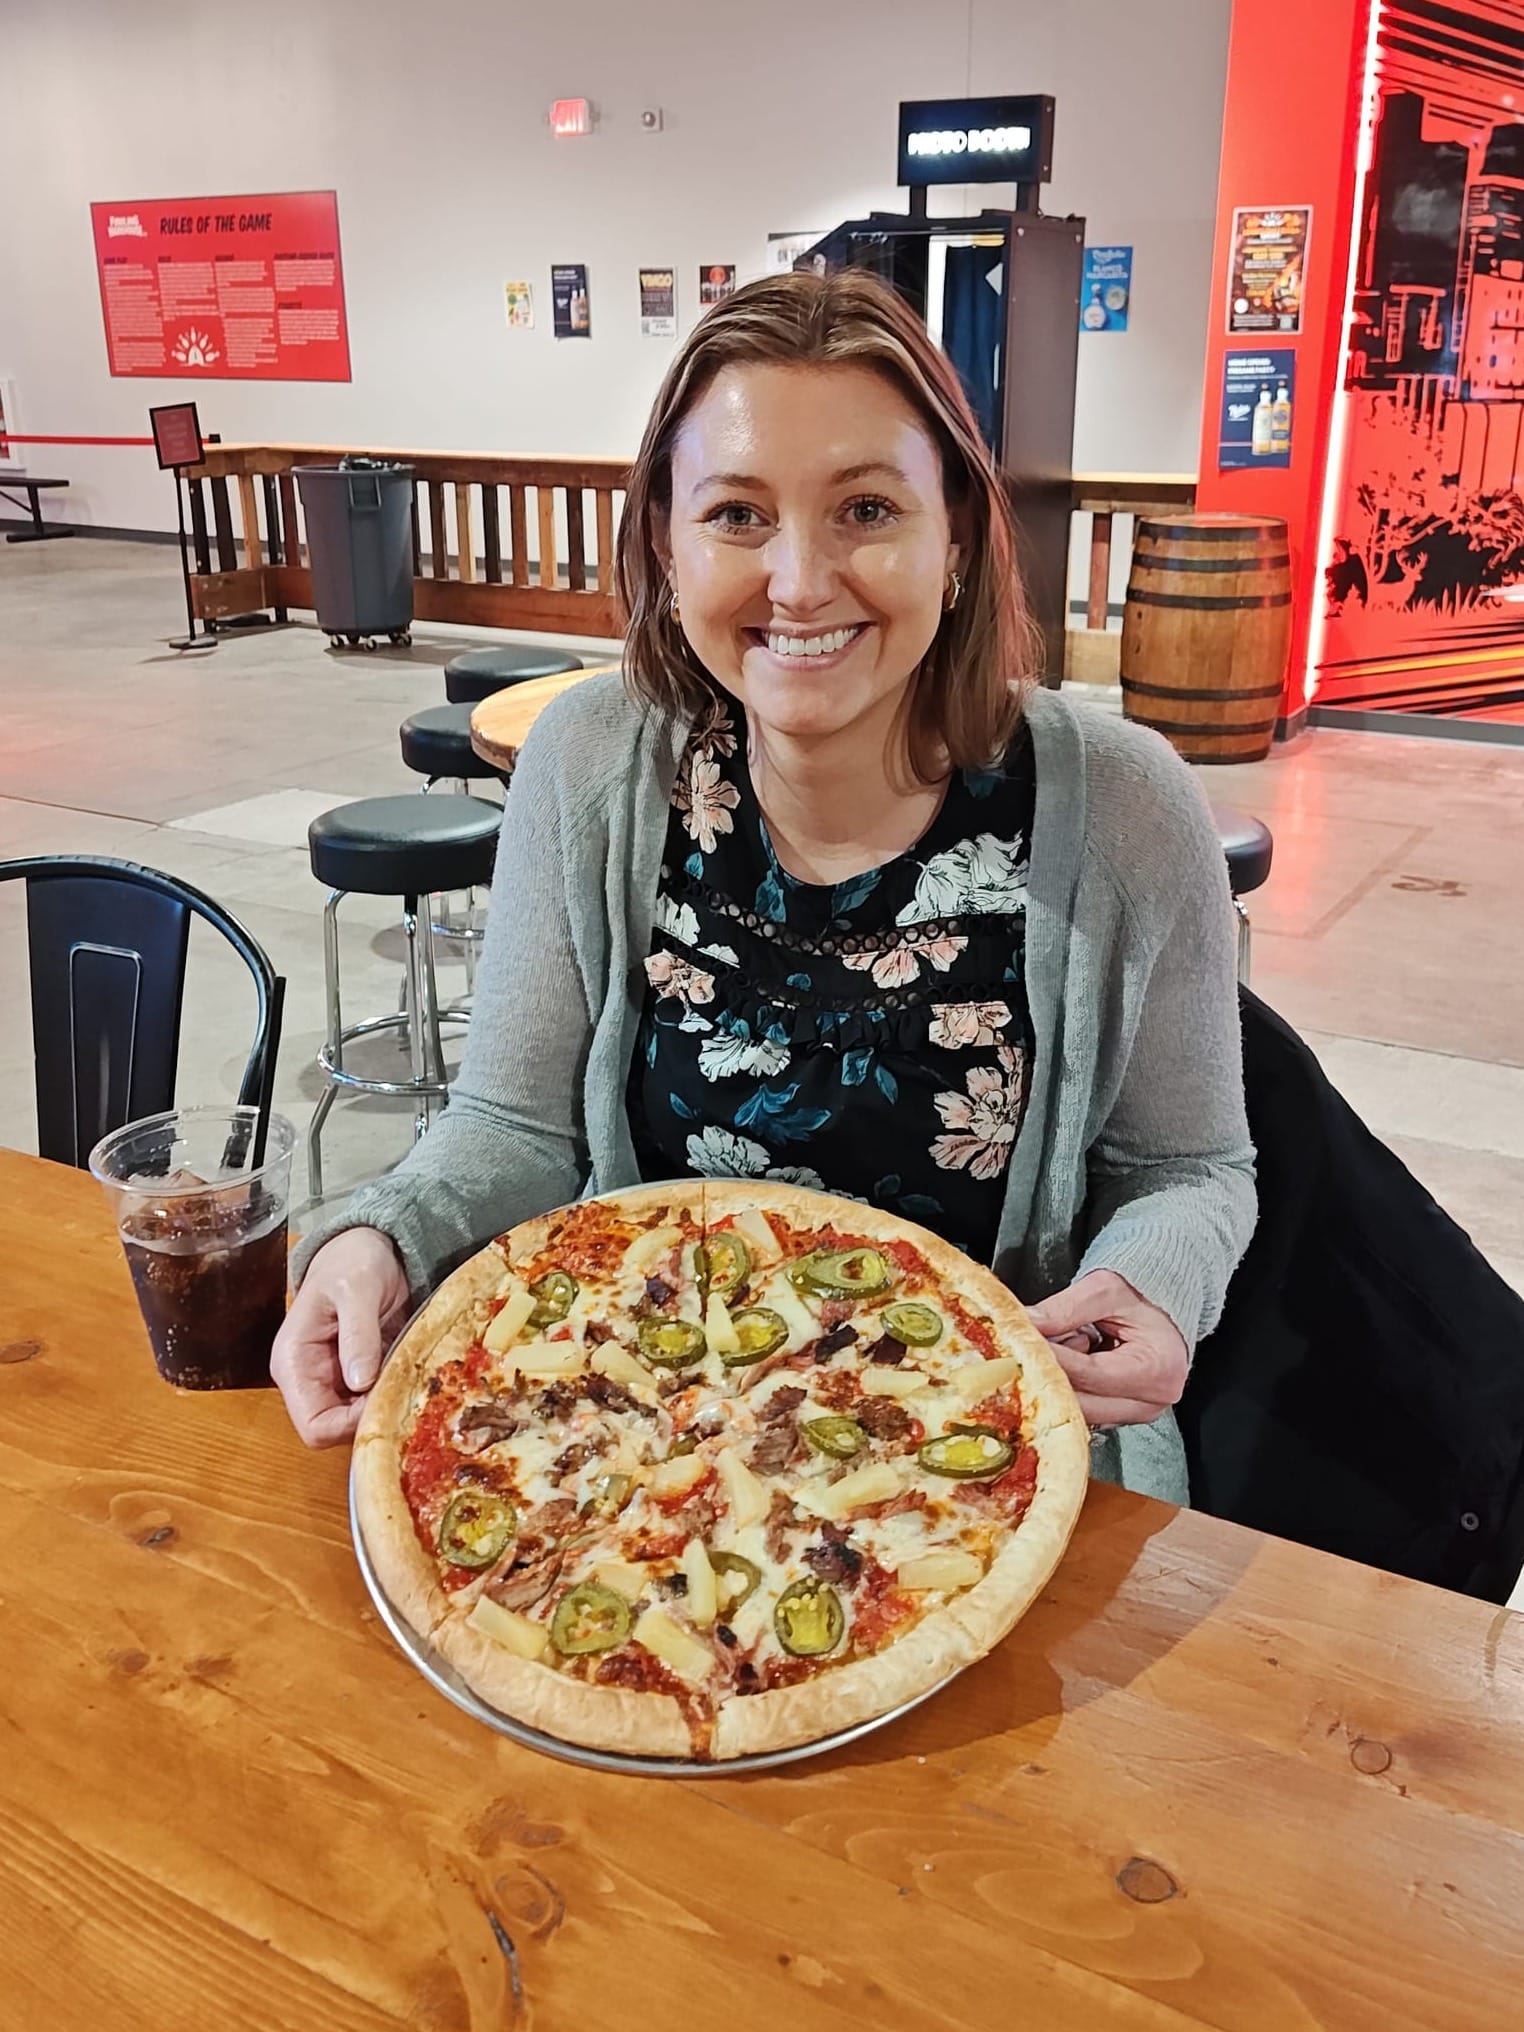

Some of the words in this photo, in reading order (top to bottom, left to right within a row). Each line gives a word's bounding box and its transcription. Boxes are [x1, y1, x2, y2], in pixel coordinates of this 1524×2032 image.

[908, 130, 967, 155] PHOTO
[968, 126, 1031, 152] BOOTH
[160, 217, 193, 235] RULES
[196, 216, 210, 233] OF
[215, 214, 236, 233] THE
[239, 213, 273, 232] GAME
